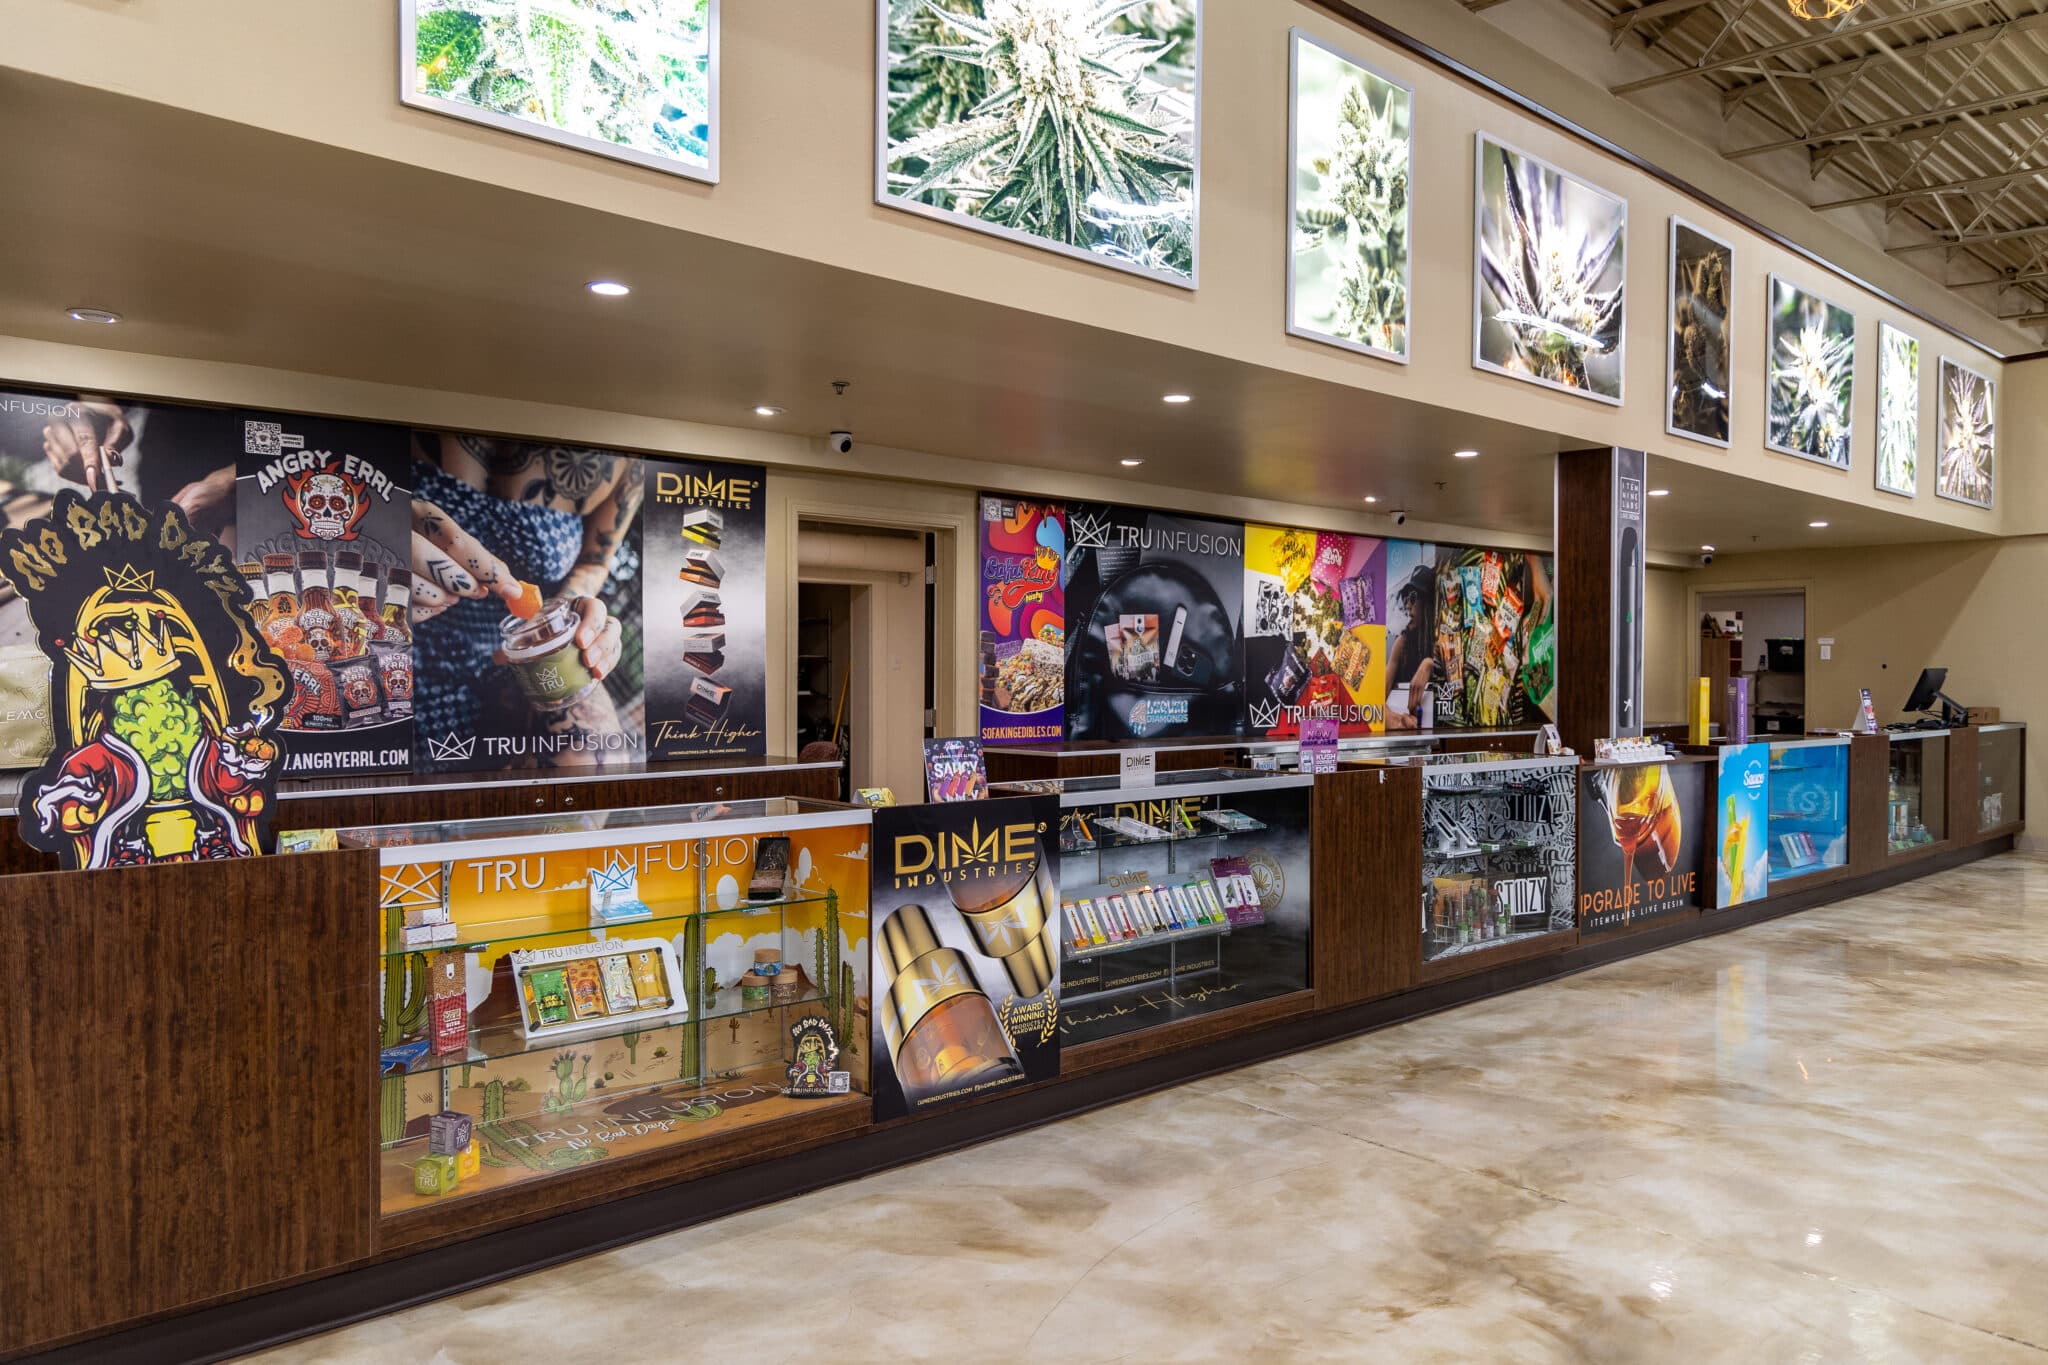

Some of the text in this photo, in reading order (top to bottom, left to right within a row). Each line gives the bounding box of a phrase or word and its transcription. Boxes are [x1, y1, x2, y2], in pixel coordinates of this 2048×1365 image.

[256, 450, 395, 502] ANGRY ERRL
[657, 470, 751, 502] DIME
[656, 495, 751, 510] INDUSTRIES
[66, 498, 147, 551] BAD
[1116, 525, 1241, 557] TRU INFUSION
[294, 667, 322, 696] ERRL
[538, 678, 565, 692] TRU
[1146, 713, 1188, 723] DIAMONDS
[1436, 701, 1456, 715] TRU
[483, 732, 638, 756] TRU INFUSION
[651, 719, 762, 748] Think Higher
[982, 725, 1062, 740] SOFAKINGEDIBLES.COM
[283, 748, 409, 771] .ANGRYERRL.COM
[1126, 754, 1151, 768] DIME
[895, 816, 1036, 876] DIME
[468, 856, 545, 893] TRU
[895, 860, 1036, 889] INDUSTRIES
[1107, 869, 1149, 888] DIME
[1647, 878, 1665, 901] TO
[1671, 871, 1696, 897] LIVE
[1640, 904, 1658, 916] LIVE
[1662, 899, 1684, 910] RESIN
[540, 940, 624, 960] TRU INFUSION
[1010, 1009, 1046, 1025] WINNING
[1013, 1001, 1043, 1016] AWARD
[504, 1081, 781, 1149] TRU INFUSION
[456, 1132, 470, 1146] TRU
[568, 1138, 591, 1151] No
[599, 1126, 631, 1142] Bad
[418, 1175, 438, 1187] TRU
